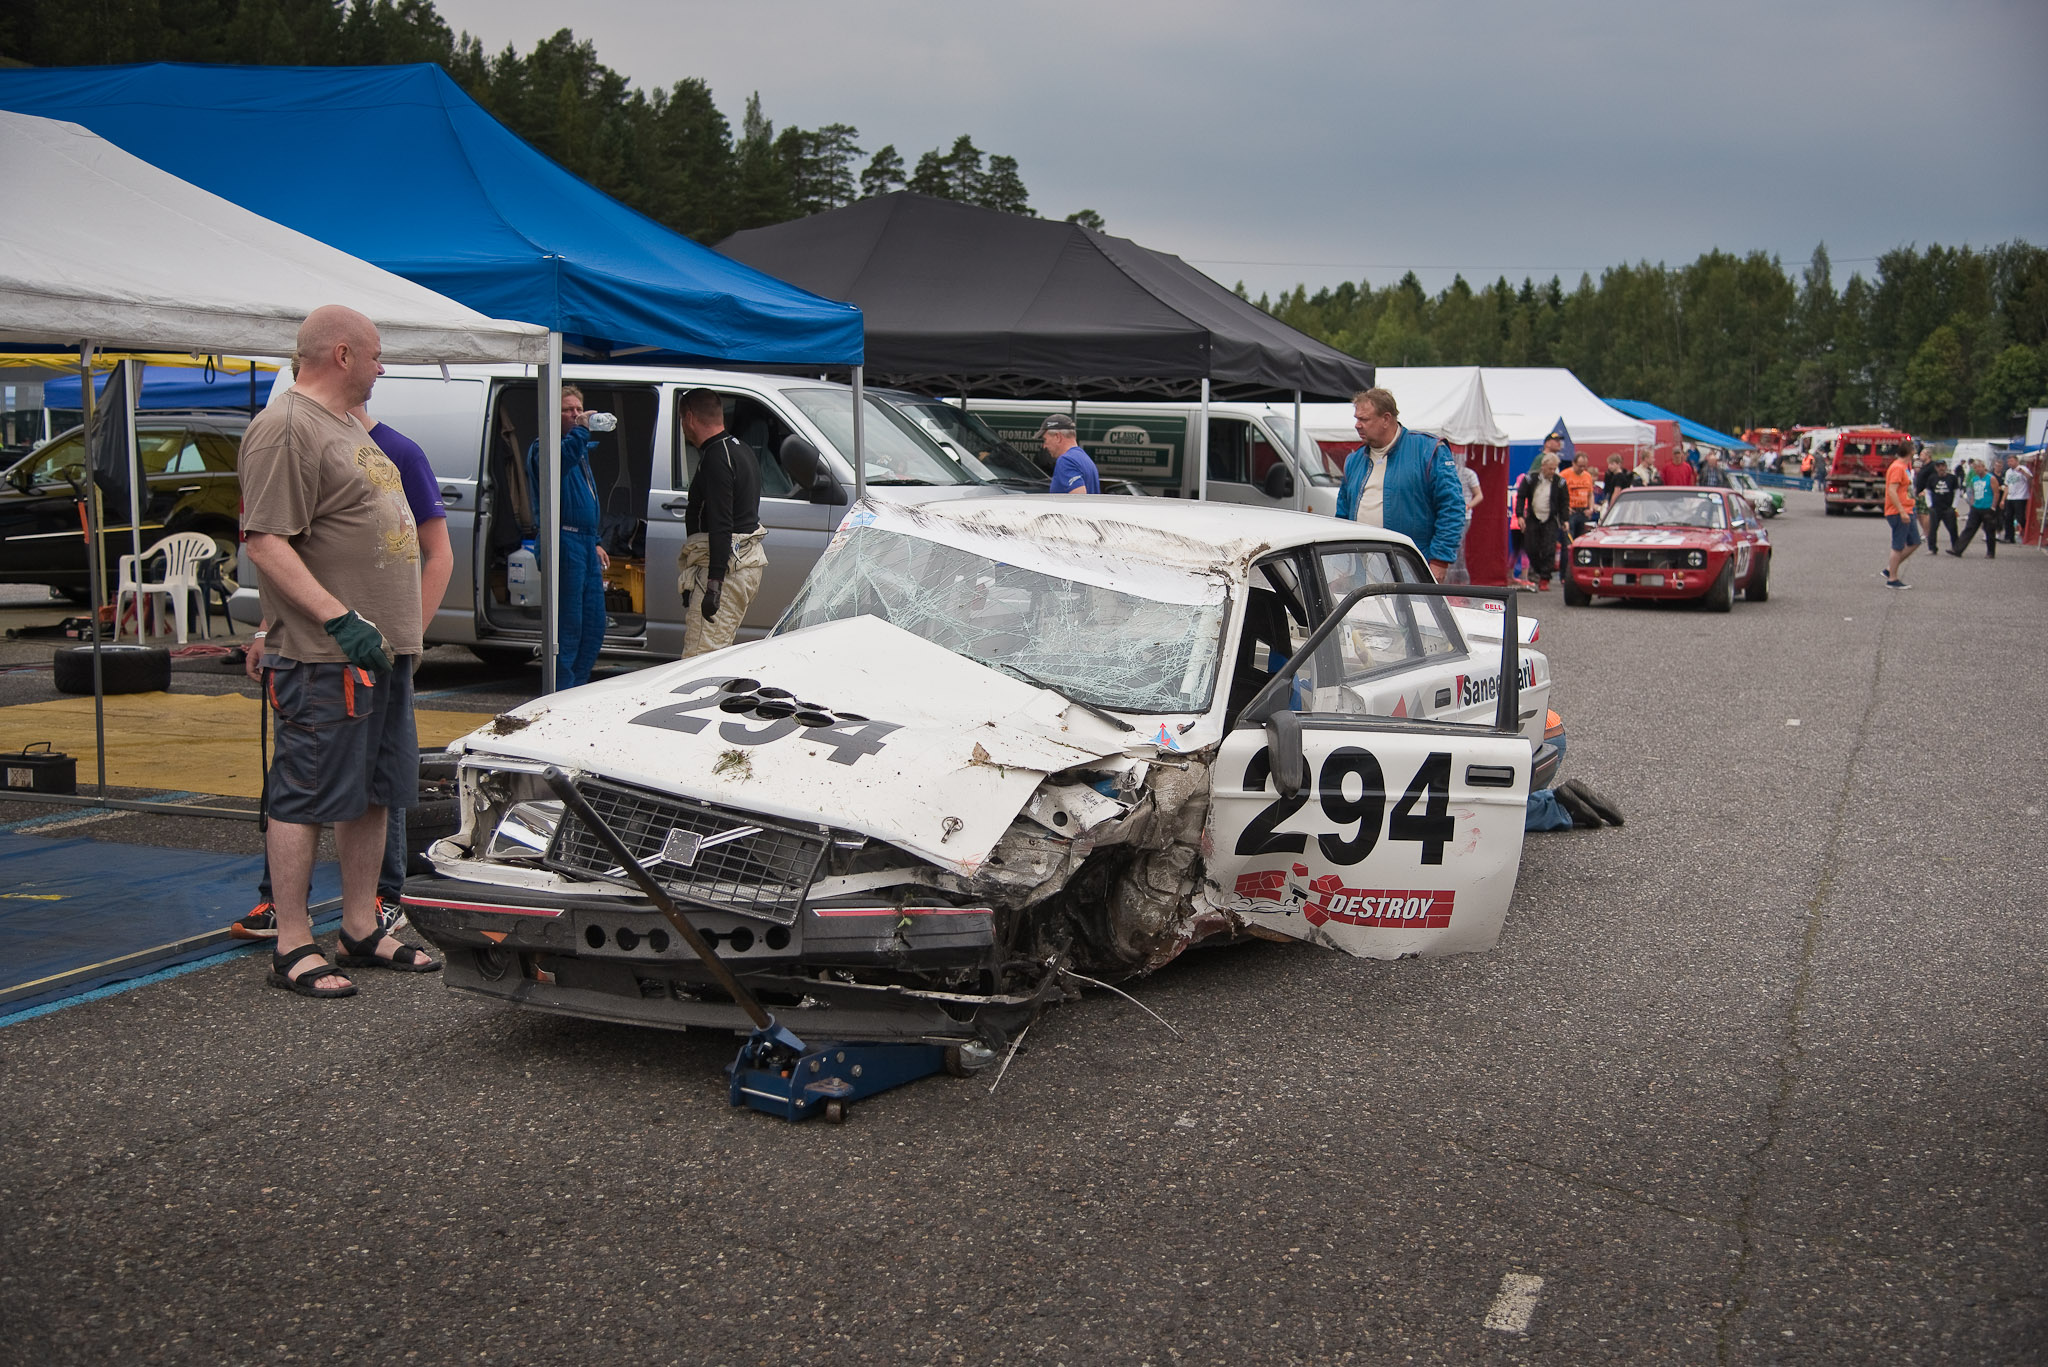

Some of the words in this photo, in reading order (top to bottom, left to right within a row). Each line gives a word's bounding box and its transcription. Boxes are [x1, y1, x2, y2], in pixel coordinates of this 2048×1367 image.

[628, 676, 905, 767] 294
[1235, 745, 1456, 866] 294
[1327, 893, 1434, 920] DESTROY
